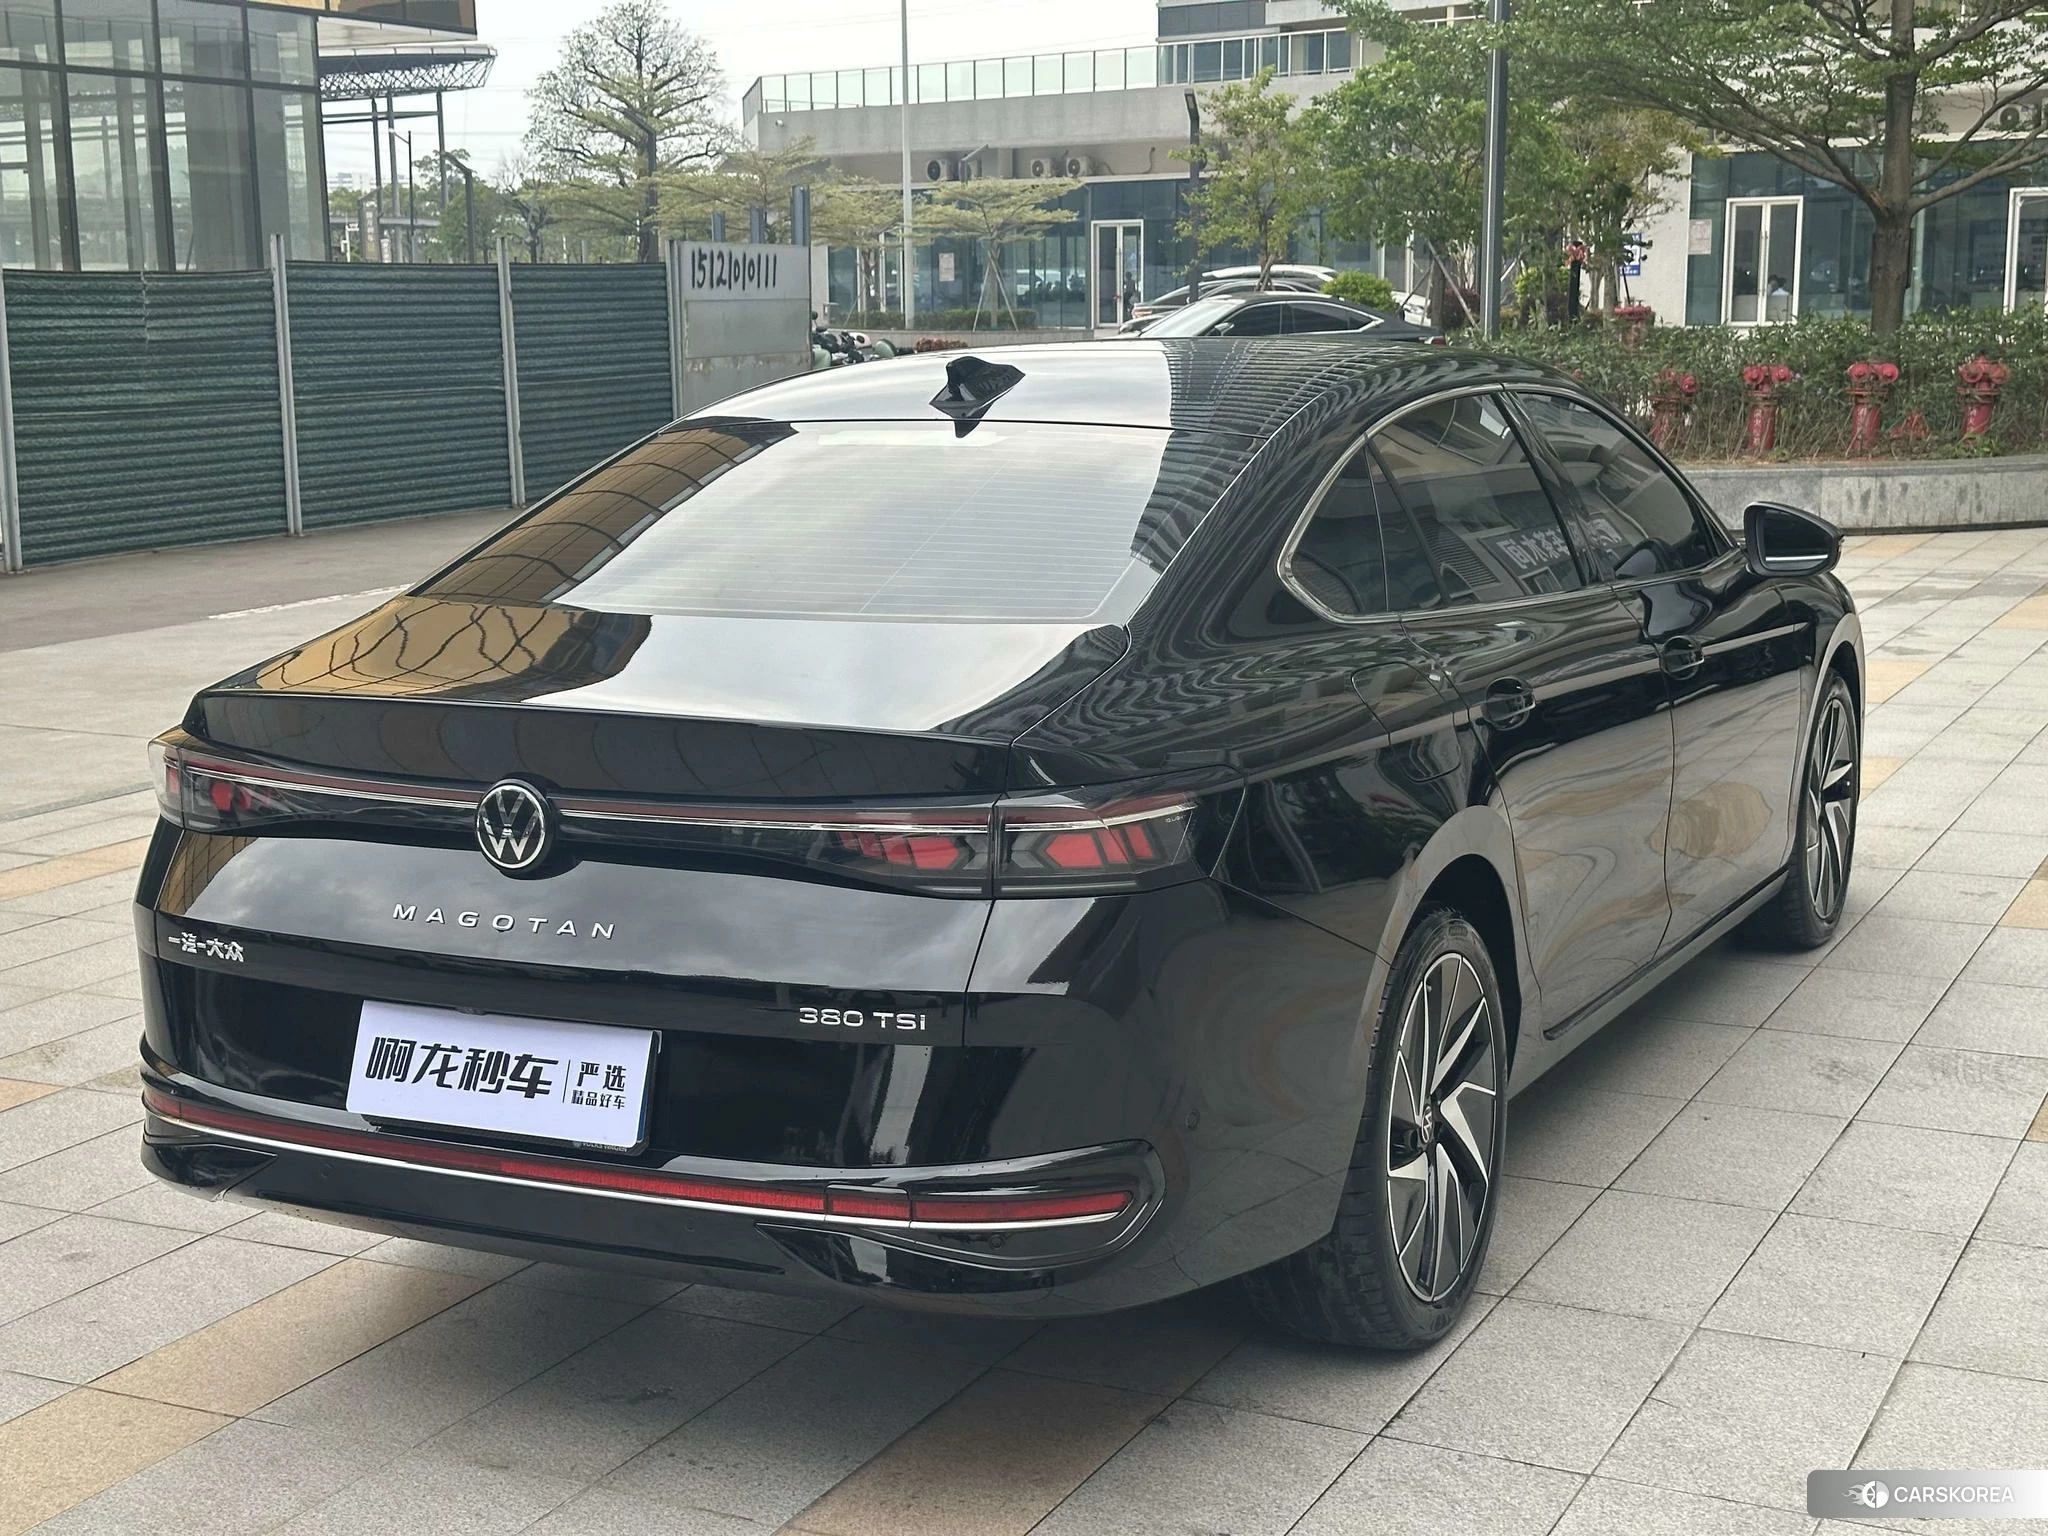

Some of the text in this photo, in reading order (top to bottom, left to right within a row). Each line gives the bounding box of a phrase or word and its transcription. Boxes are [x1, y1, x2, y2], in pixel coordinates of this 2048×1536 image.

[392, 903, 616, 940] MAGOTAN
[799, 1007, 863, 1027] 380
[577, 1061, 626, 1092] 严选
[571, 1089, 626, 1109] 精品好车
